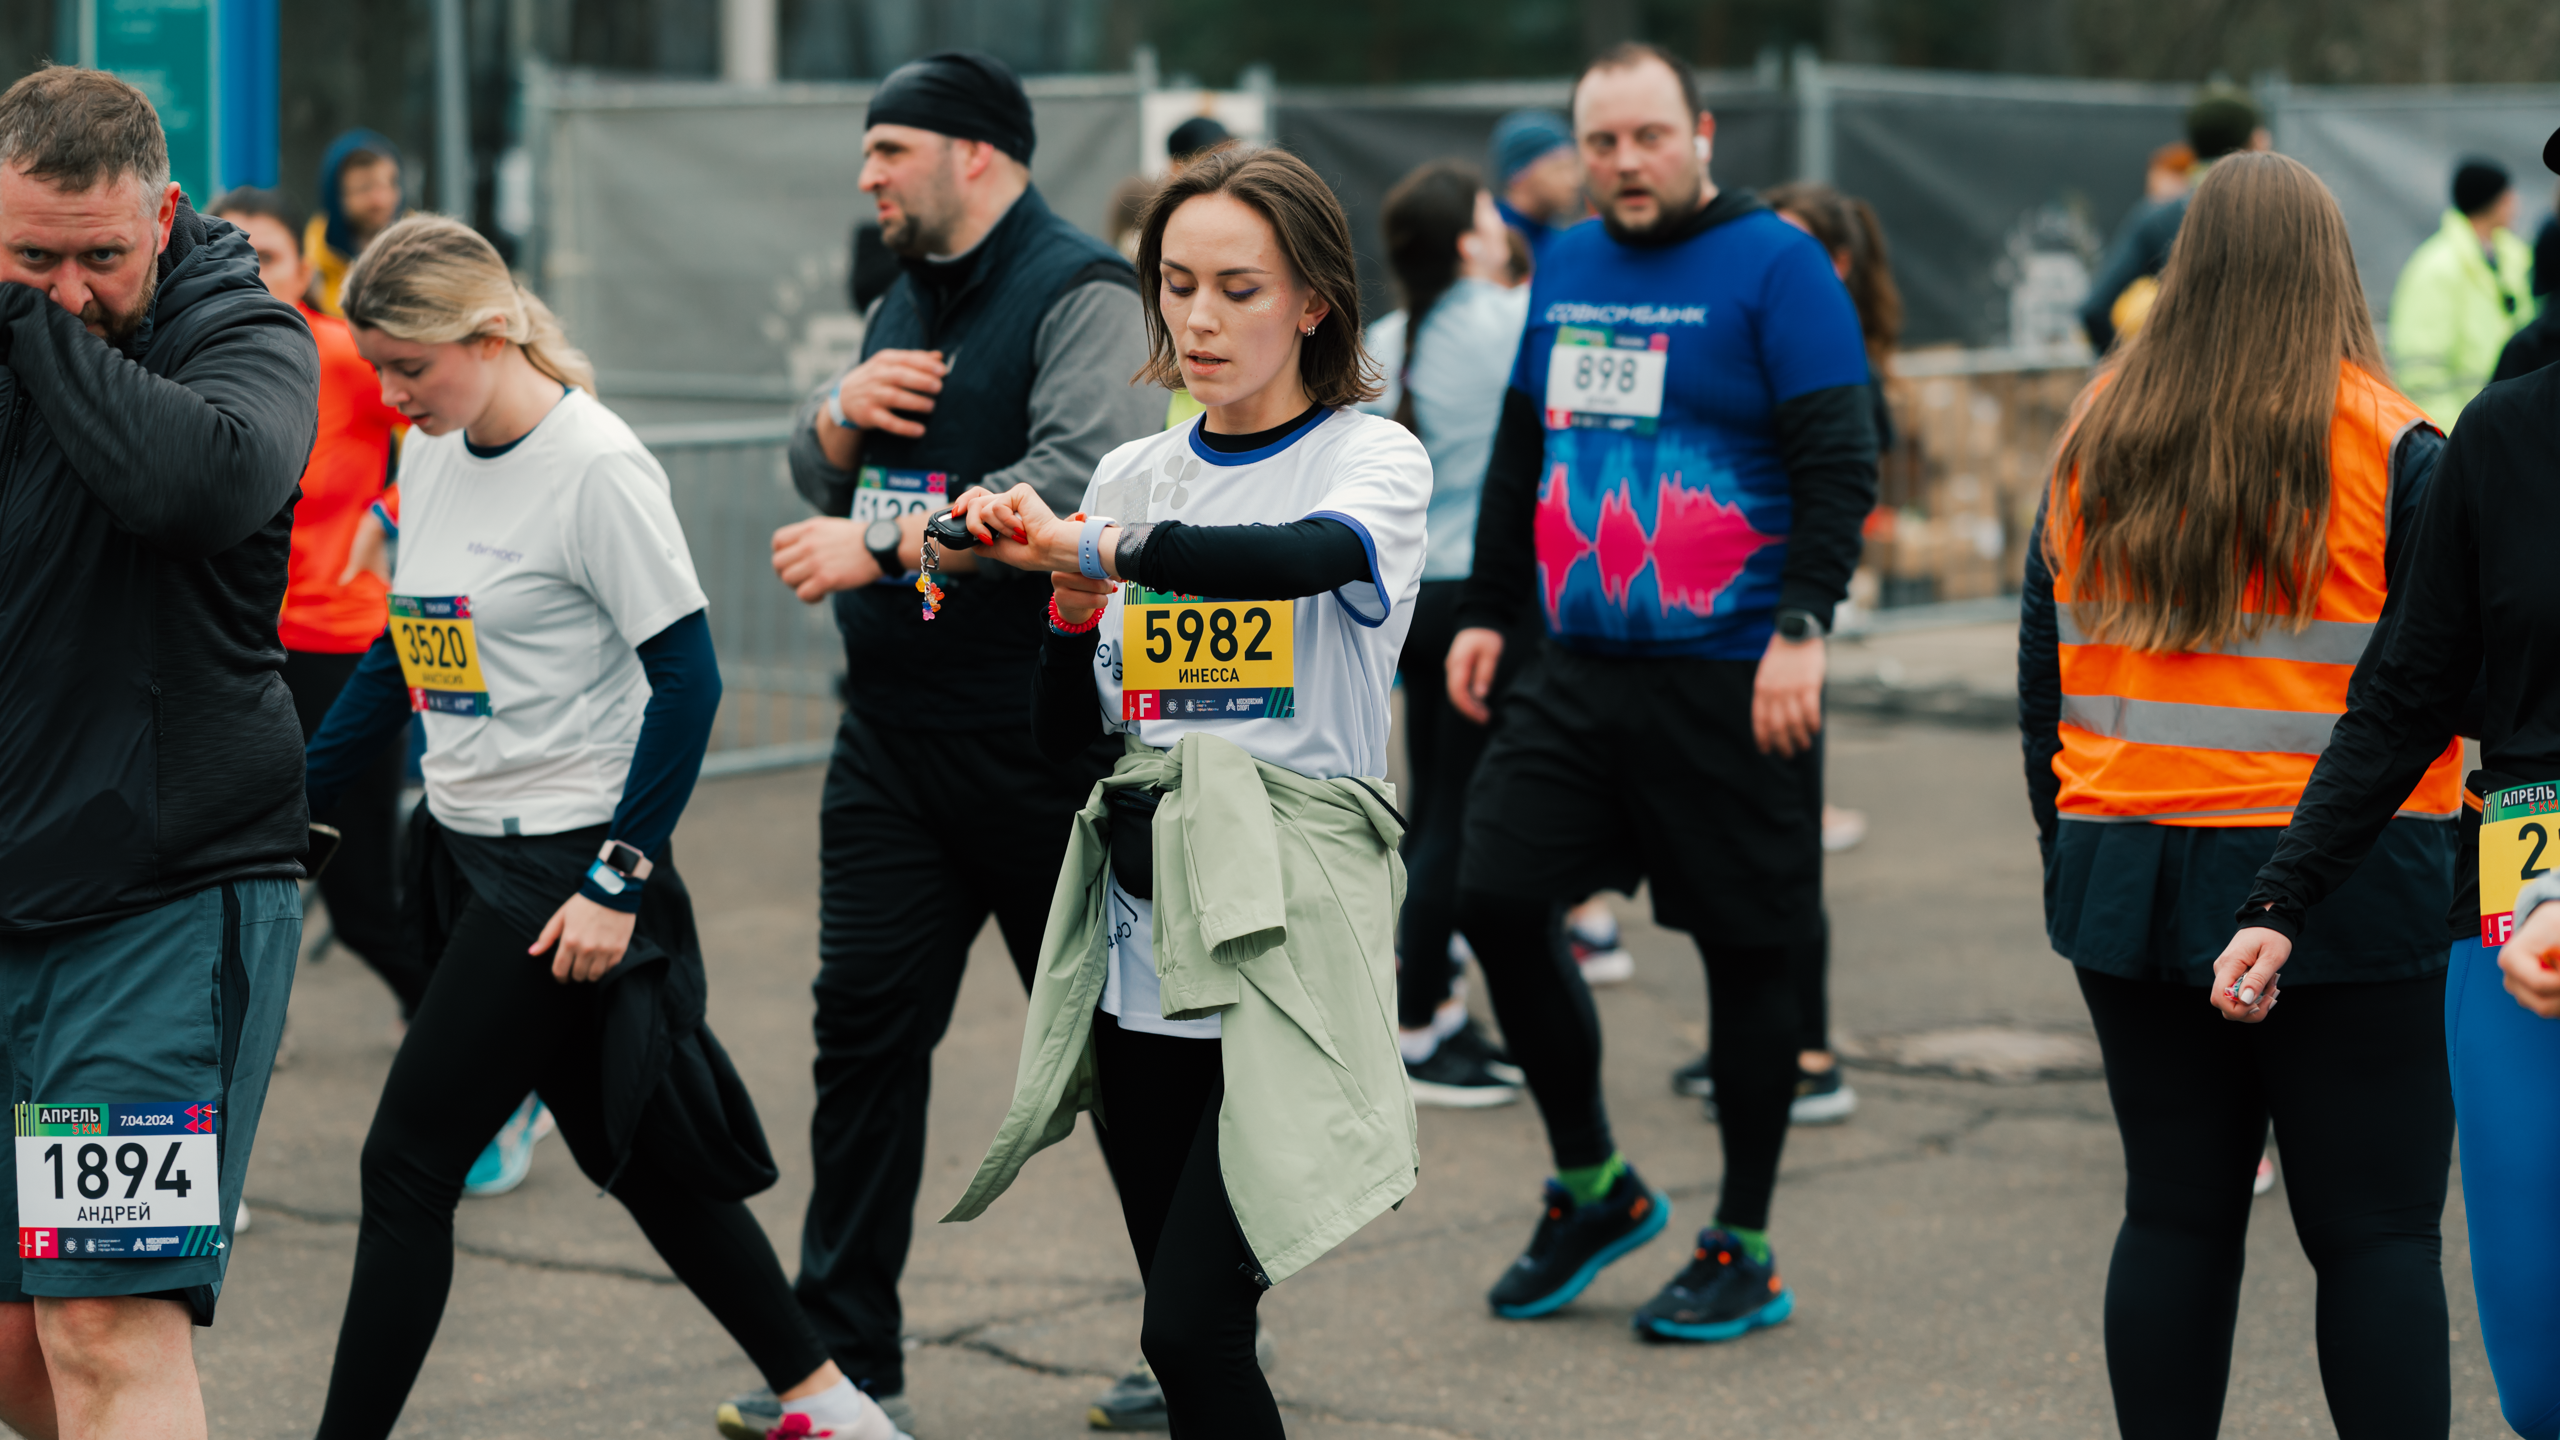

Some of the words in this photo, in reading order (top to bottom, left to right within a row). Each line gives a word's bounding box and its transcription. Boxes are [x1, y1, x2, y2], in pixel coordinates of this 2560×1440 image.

[1575, 355, 1637, 393] 898
[402, 623, 467, 669] 3520
[1146, 607, 1273, 663] 5982
[1179, 668, 1240, 683] ИНЕССА
[1139, 693, 1153, 717] F
[2502, 785, 2556, 807] АПРЕЛЬ
[2529, 802, 2536, 814] 5
[2518, 822, 2560, 880] 2
[2498, 915, 2512, 942] F
[41, 1109, 99, 1123] АПРЕЛЬ
[120, 1115, 174, 1126] 7.04.2024
[72, 1123, 79, 1135] 5
[44, 1141, 192, 1200] 1894
[77, 1202, 151, 1224] АНДРЕЙ
[35, 1231, 50, 1256] F
